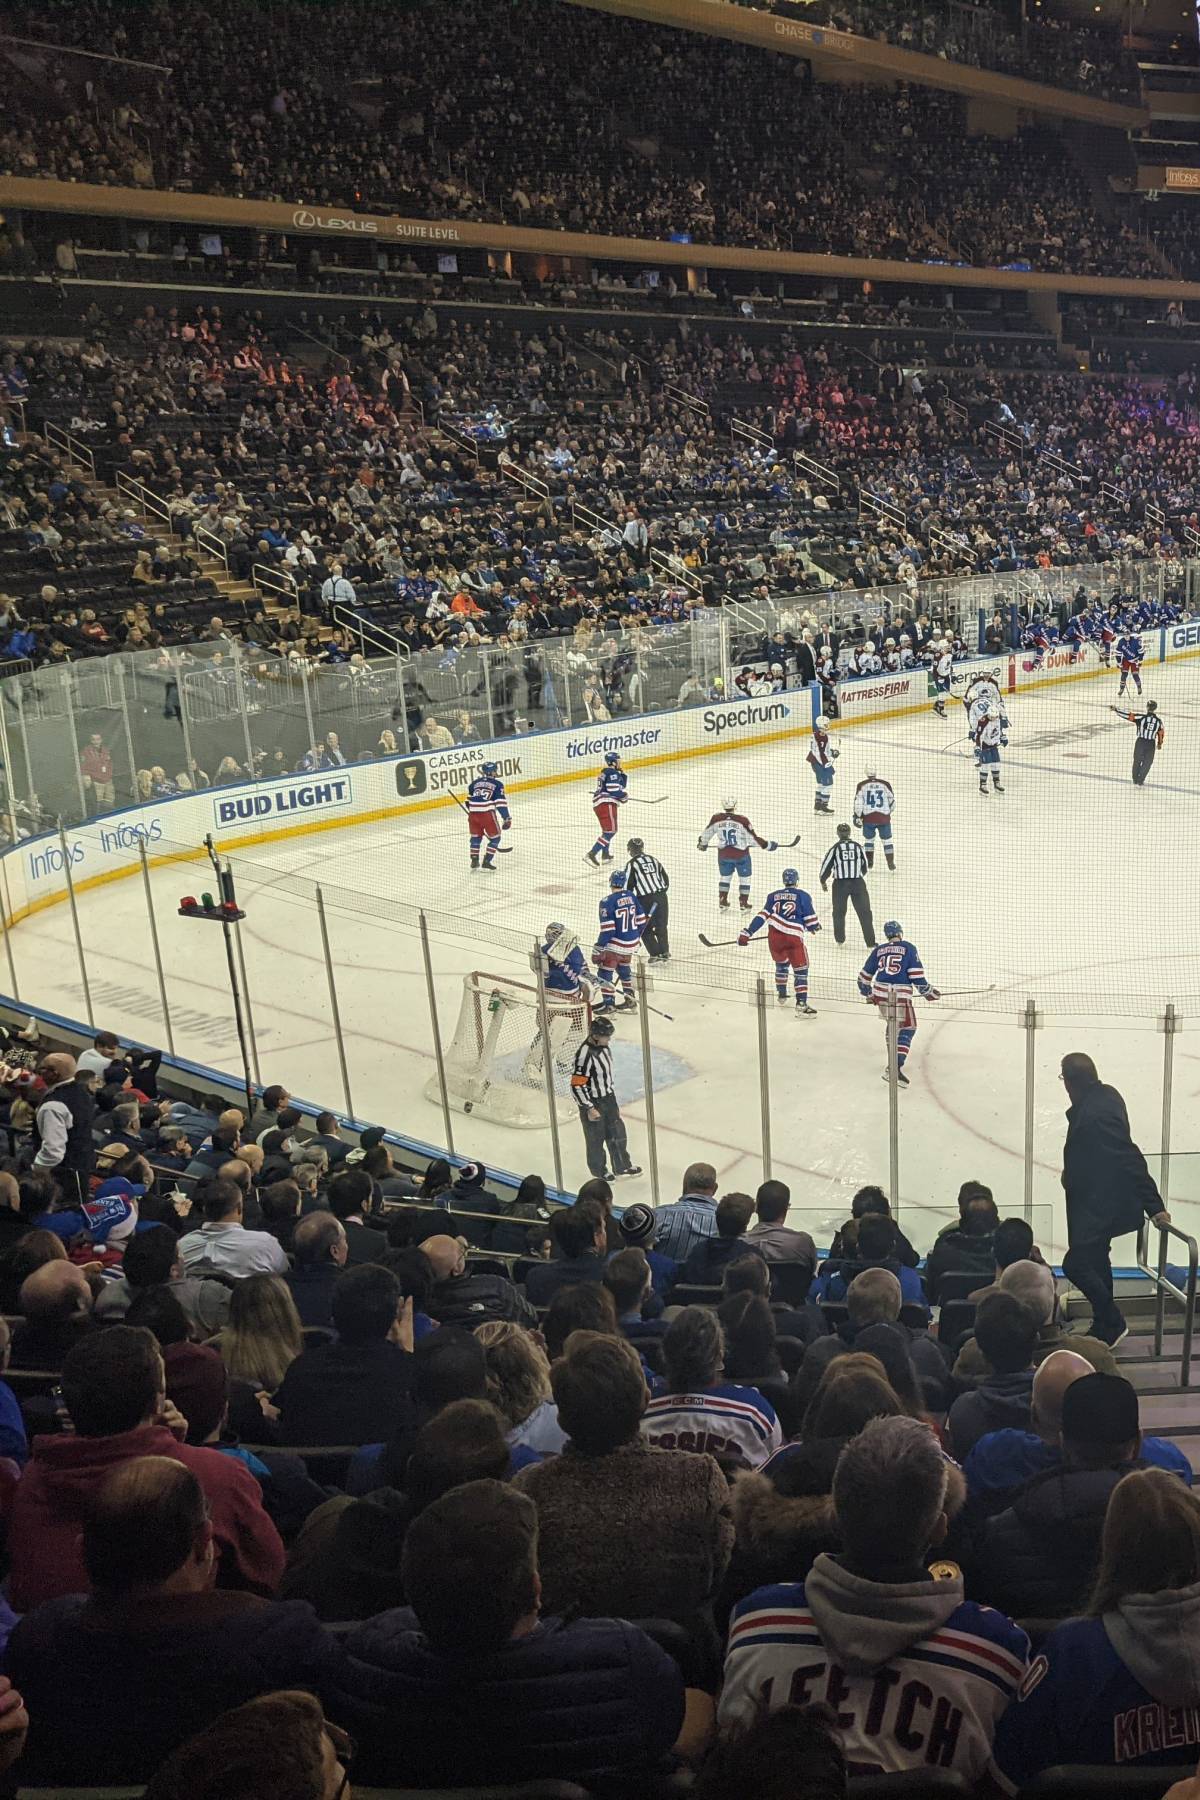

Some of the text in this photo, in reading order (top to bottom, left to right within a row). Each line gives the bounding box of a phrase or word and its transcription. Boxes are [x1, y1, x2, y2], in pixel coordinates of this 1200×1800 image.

[775, 22, 811, 40] CHASE
[317, 216, 460, 241] LEXUS SUITE LEVEL
[703, 703, 785, 736] Spectrum
[566, 728, 661, 759] ticketmaster
[428, 749, 484, 769] CAESARS
[219, 781, 346, 823] BUD LIGHT
[866, 790, 884, 808] 43
[100, 818, 162, 854] Infosys
[722, 829, 738, 845] 16
[29, 840, 85, 880] Infoys
[842, 850, 855, 860] 60
[642, 862, 654, 874] 50
[614, 905, 638, 933] 72
[772, 902, 797, 919] 12
